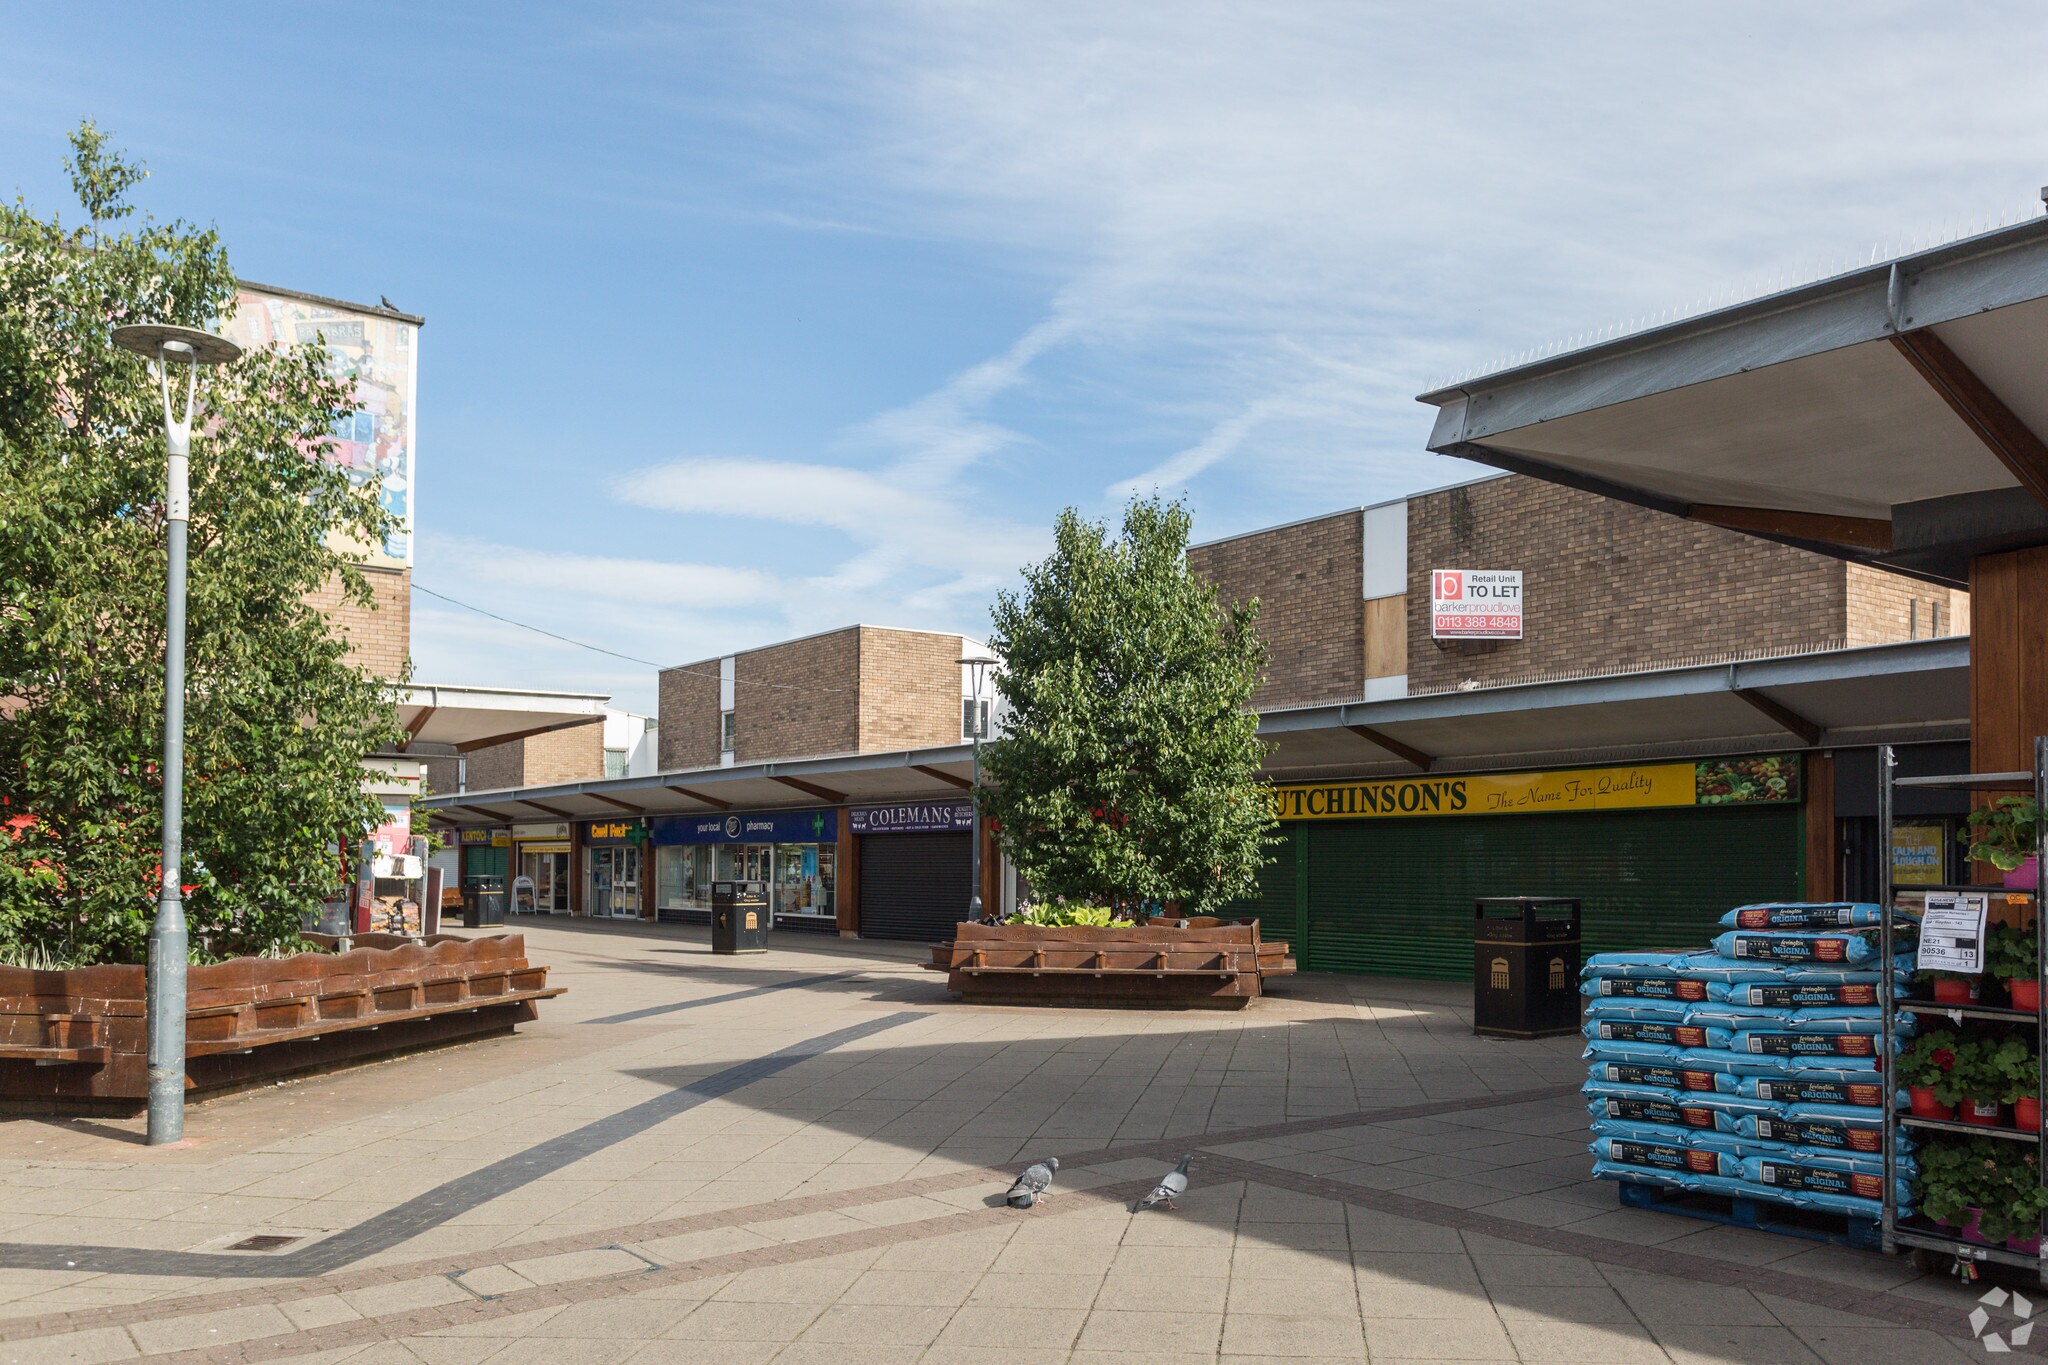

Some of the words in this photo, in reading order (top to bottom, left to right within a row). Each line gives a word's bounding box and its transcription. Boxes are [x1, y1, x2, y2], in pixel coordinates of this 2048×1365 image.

[1472, 575, 1496, 583] Retail
[1499, 575, 1515, 583] Unit
[1468, 586, 1488, 597] TO
[1493, 586, 1519, 597] LET
[1435, 602, 1520, 613] barkerproudlove
[1437, 616, 1461, 628] 0113
[1465, 616, 1486, 628] 388
[1490, 616, 1518, 628] 4848
[1487, 791, 1513, 810] The
[1517, 787, 1561, 806] Name
[1565, 780, 1593, 802] For
[1597, 770, 1652, 794] Quality
[1258, 781, 1467, 815] UTCHINSON'S
[870, 806, 951, 826] COLEMANS
[697, 824, 708, 834] your
[708, 822, 720, 832] local
[746, 821, 774, 832] pharmacy
[1892, 846, 1915, 856] CALM
[1917, 845, 1937, 855] AND
[1926, 856, 1939, 866] ON
[1771, 914, 1809, 923] ORIGINAL
[1772, 946, 1811, 955] ORIGINAL
[1636, 986, 1673, 995] ORIGINAL
[1792, 993, 1835, 1001] ORIGINAL
[1636, 1031, 1672, 1040] ORIGINAL
[1801, 1091, 1844, 1100] ORIGINAL
[1801, 1132, 1844, 1144] ORIGINAL
[1647, 1153, 1683, 1164] ORIGINAL
[1804, 1176, 1846, 1188] ORIGINAL
